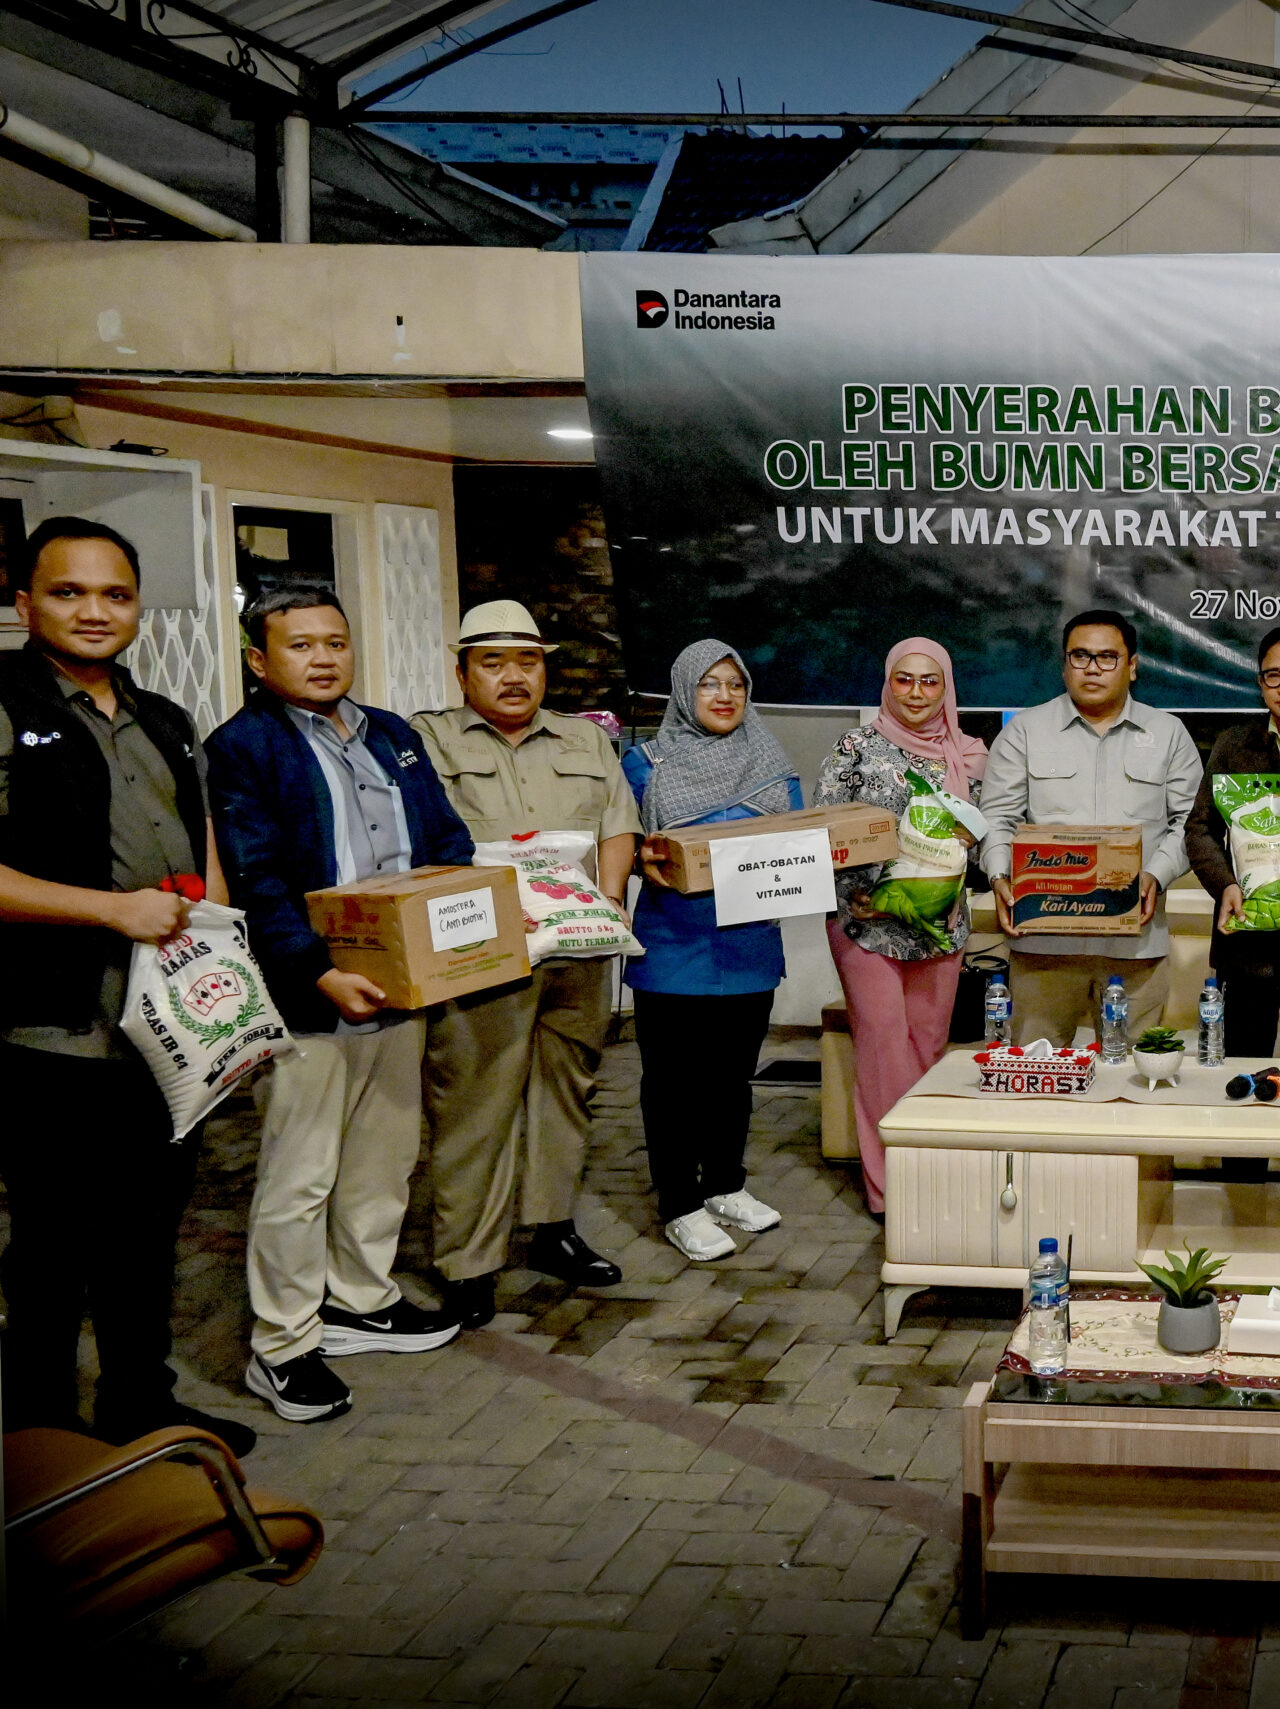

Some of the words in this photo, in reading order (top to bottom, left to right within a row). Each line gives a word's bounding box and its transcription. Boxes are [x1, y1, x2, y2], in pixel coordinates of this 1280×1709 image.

[674, 289, 781, 309] Danantara
[674, 312, 775, 330] Indonesia
[842, 384, 1228, 436] PENYERAHAN
[765, 440, 917, 492] OLEH
[931, 441, 1105, 493] BUMN
[776, 507, 940, 545] UNTUK
[951, 508, 1267, 548] MASYARAKAT
[1190, 590, 1227, 619] 27
[738, 855, 816, 872] OBAT-OBATAN
[774, 874, 782, 883] &
[756, 886, 802, 900] VITAMIN
[1040, 901, 1068, 913] Kari
[1069, 901, 1105, 915] Ayam
[557, 926, 592, 935] BRUTTO
[557, 937, 583, 948] MUTU
[141, 993, 168, 1036] ERAS
[161, 1035, 179, 1053] IR
[172, 1053, 189, 1071] 64
[996, 1076, 1073, 1093] HORAS
